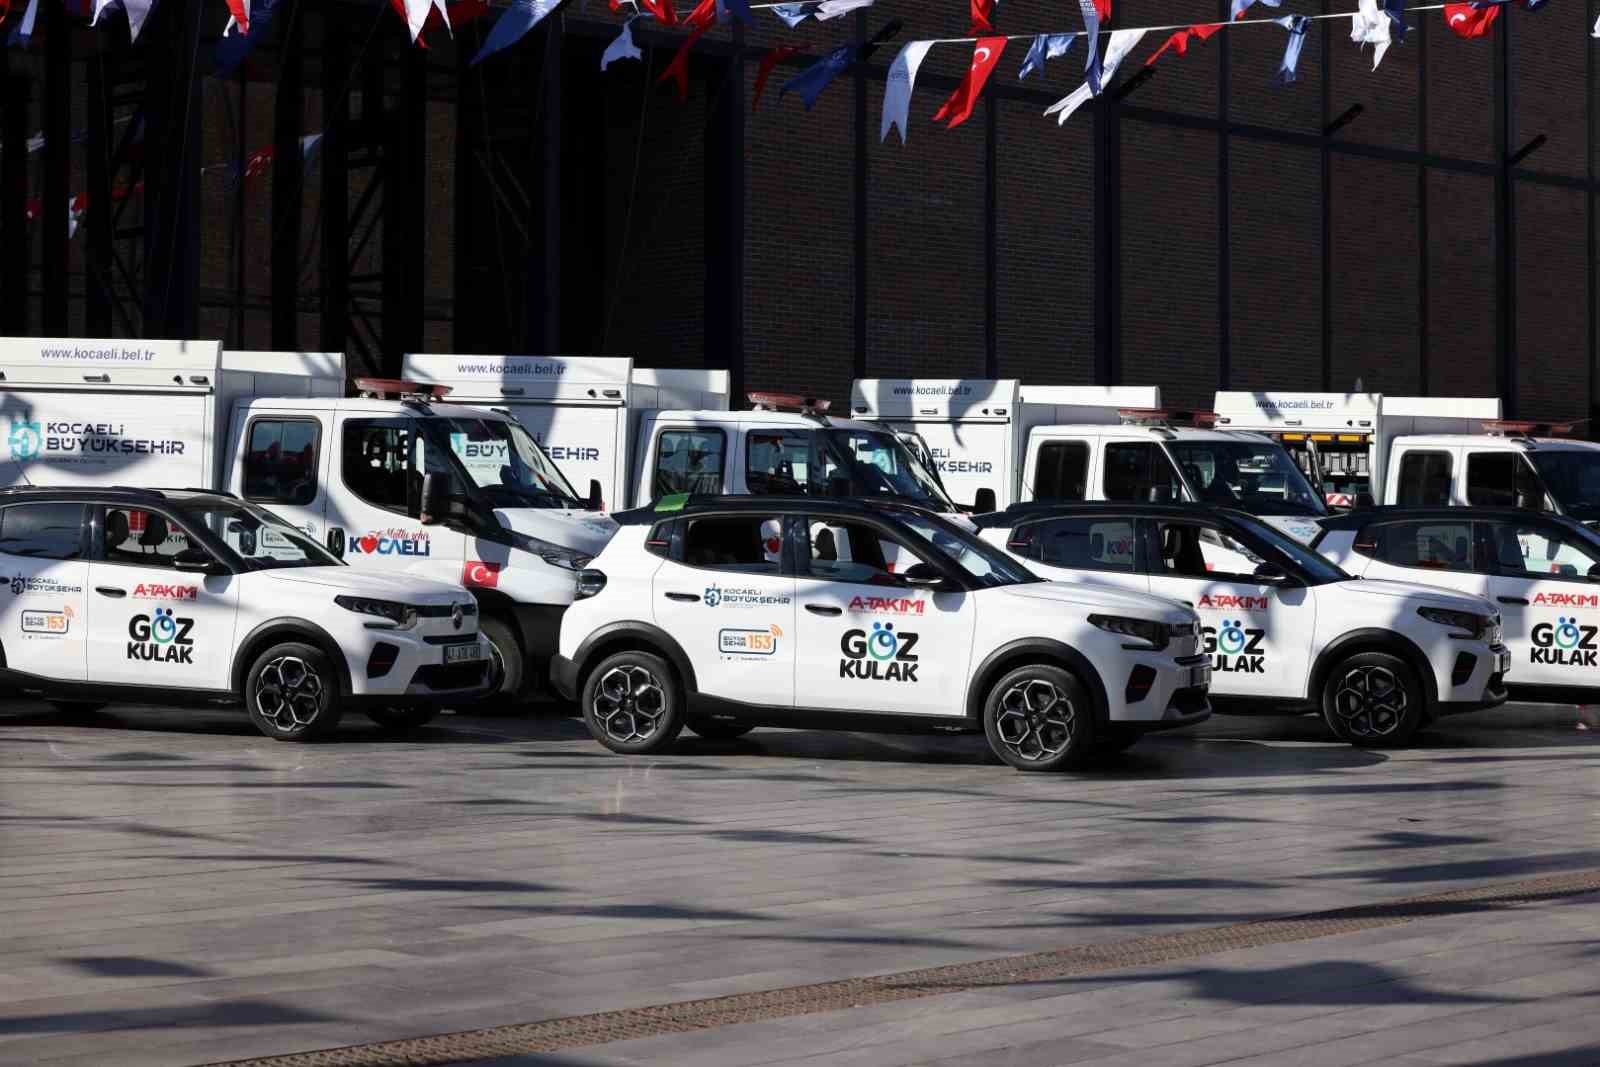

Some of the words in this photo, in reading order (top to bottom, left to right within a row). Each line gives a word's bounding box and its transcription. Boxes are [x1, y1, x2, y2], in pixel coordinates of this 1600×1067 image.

[41, 347, 156, 361] www.kocaeli.bel.tr
[457, 363, 567, 375] www.kocaeli.bel.tr
[893, 384, 972, 395] www.kocaeli.bel.tr
[1255, 400, 1334, 409] www.kocaeli.bel.tr
[134, 583, 198, 600] A-TAKIMI
[1534, 593, 1598, 606] A-TAKIMI
[849, 596, 925, 613] A-TAKIMI
[1199, 594, 1268, 608] A-TAKIMI
[128, 607, 194, 645] GÖZ
[1531, 616, 1598, 649] GÖZ
[748, 634, 772, 649] 153
[840, 621, 919, 661] GÖZ
[1201, 620, 1265, 655] GÖZ
[127, 641, 193, 664] KULAK
[1530, 647, 1598, 666] KULAK
[840, 659, 919, 682] KULAK
[1211, 654, 1265, 673] ULAK
